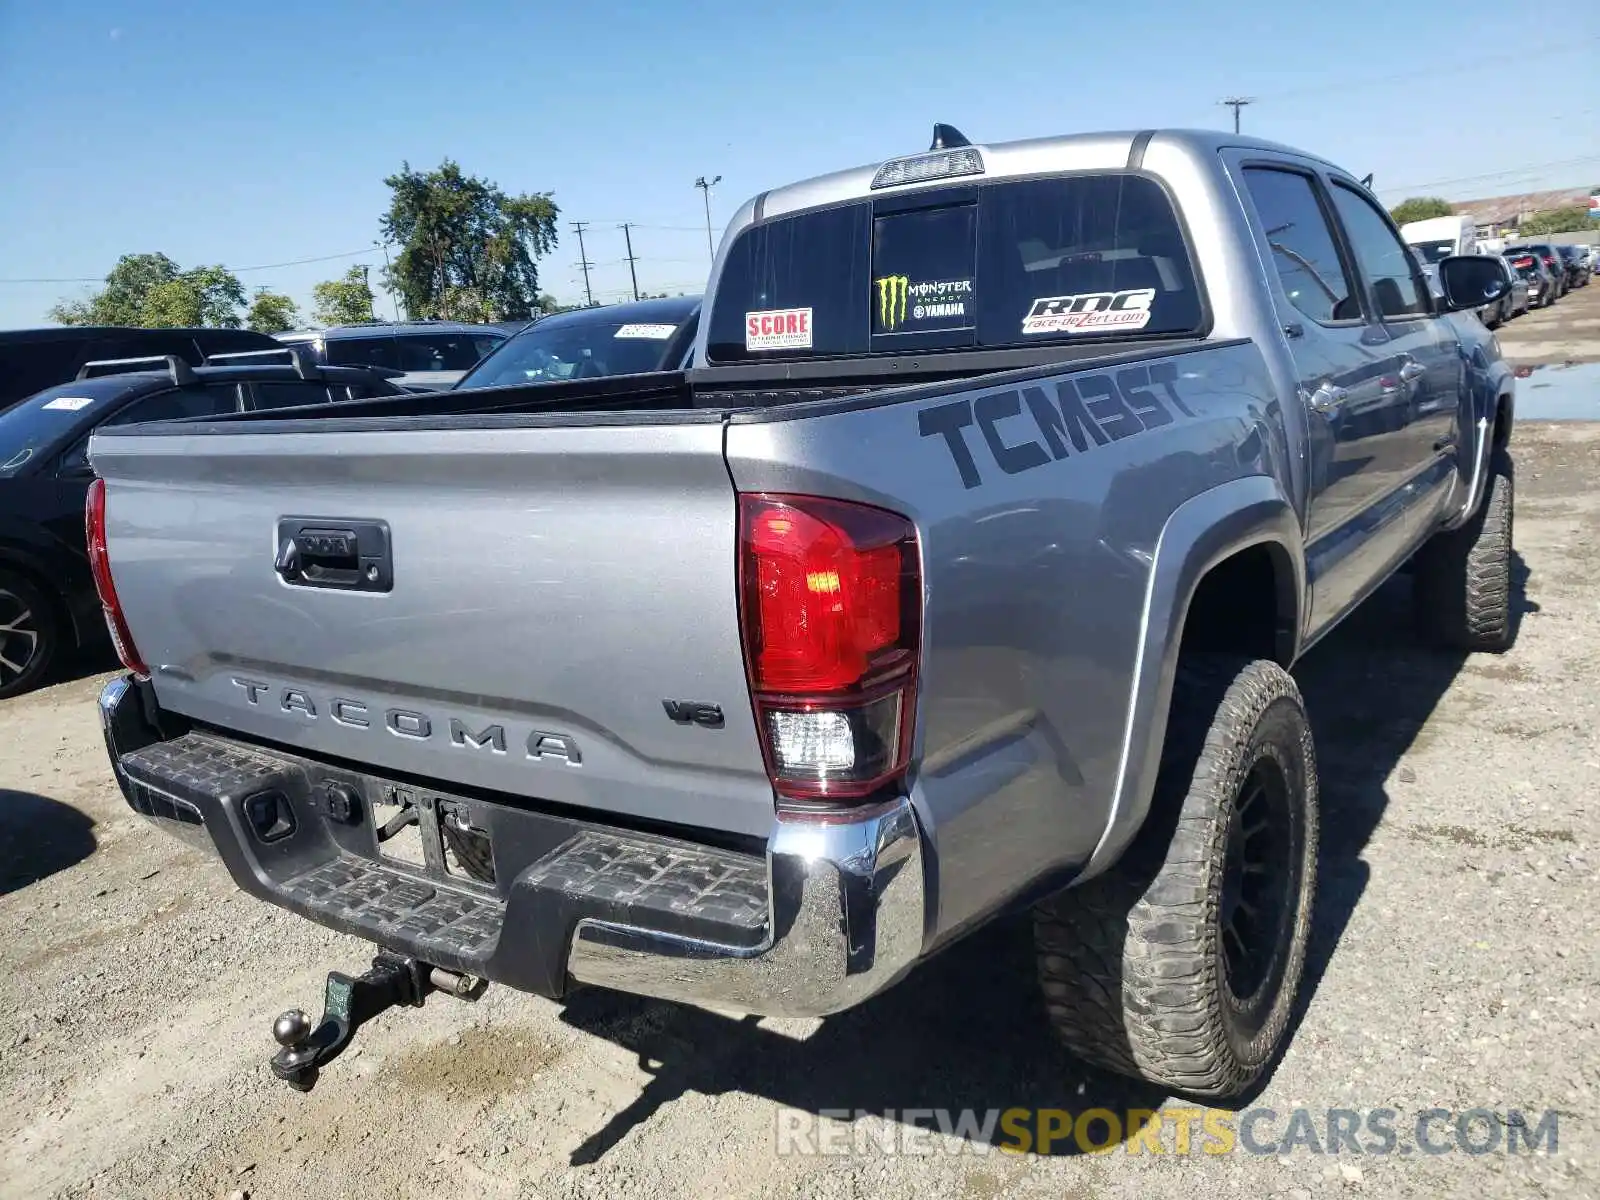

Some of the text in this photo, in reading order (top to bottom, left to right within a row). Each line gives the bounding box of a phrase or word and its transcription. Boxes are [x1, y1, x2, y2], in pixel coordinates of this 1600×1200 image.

[908, 281, 972, 297] MONSTER
[925, 303, 965, 317] YAMAHA
[1031, 292, 1153, 318] RDC
[748, 312, 808, 336] SCORE
[231, 677, 584, 767] TACOMA
[661, 699, 725, 729] V6
